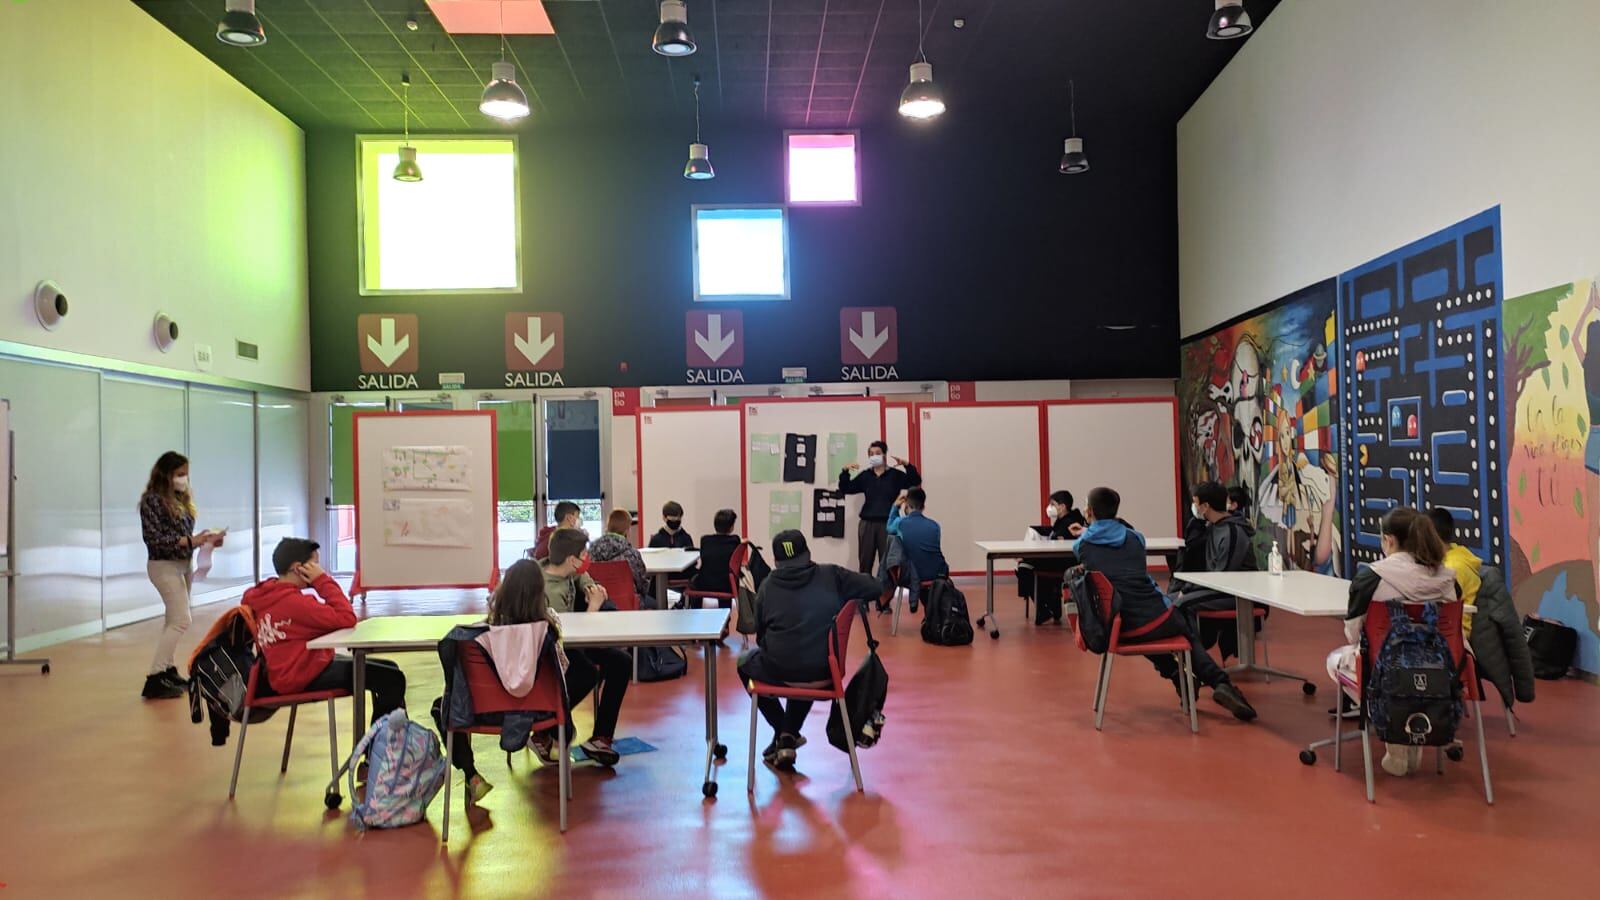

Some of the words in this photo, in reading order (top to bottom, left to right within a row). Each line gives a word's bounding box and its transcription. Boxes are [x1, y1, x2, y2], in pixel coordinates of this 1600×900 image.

[504, 371, 565, 387] SALIDA
[686, 368, 745, 384] SALIDA
[841, 365, 899, 381] SALIDA
[358, 374, 419, 389] SALIDA
[950, 384, 961, 394] pa
[614, 391, 625, 400] pa
[614, 398, 625, 407] tio
